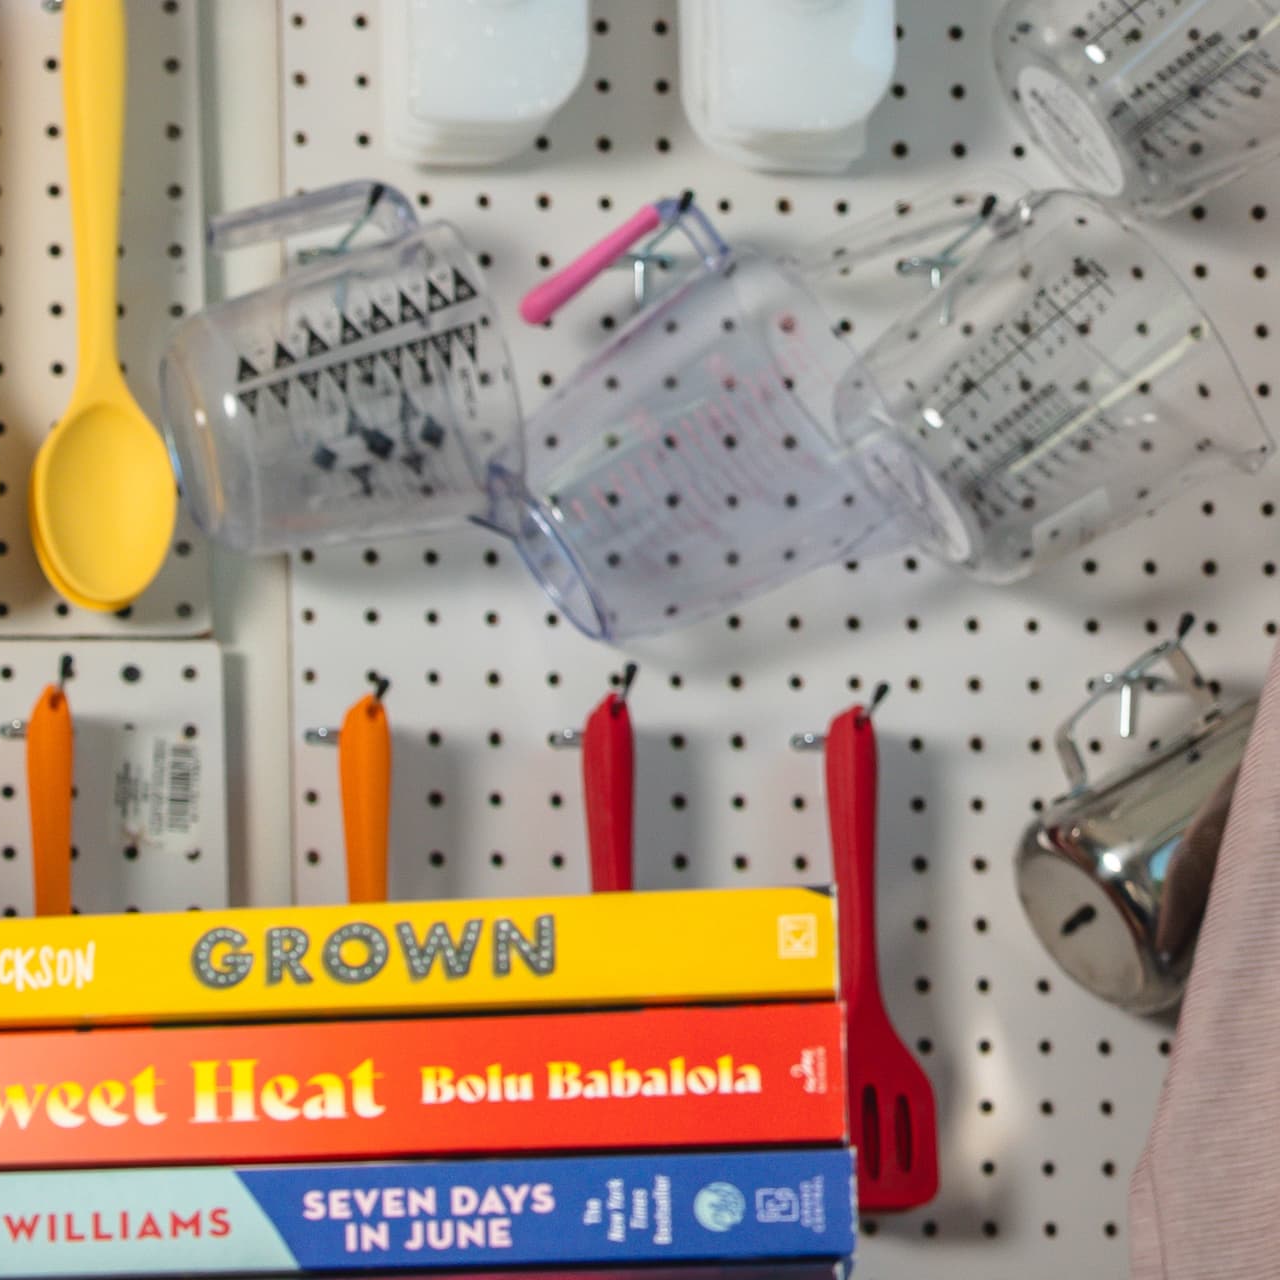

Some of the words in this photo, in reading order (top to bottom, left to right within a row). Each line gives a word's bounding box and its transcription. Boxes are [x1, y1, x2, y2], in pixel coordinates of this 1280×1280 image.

[191, 913, 557, 990] GROWN
[187, 1058, 387, 1124] Heat
[420, 1062, 534, 1105] Bolu
[546, 1054, 763, 1101] Babalola
[302, 1187, 438, 1221] SEVEN
[449, 1184, 556, 1218] DAYS
[3, 1207, 233, 1243] WILLIAMS
[344, 1222, 390, 1253] IN
[404, 1218, 514, 1252] JUNE
